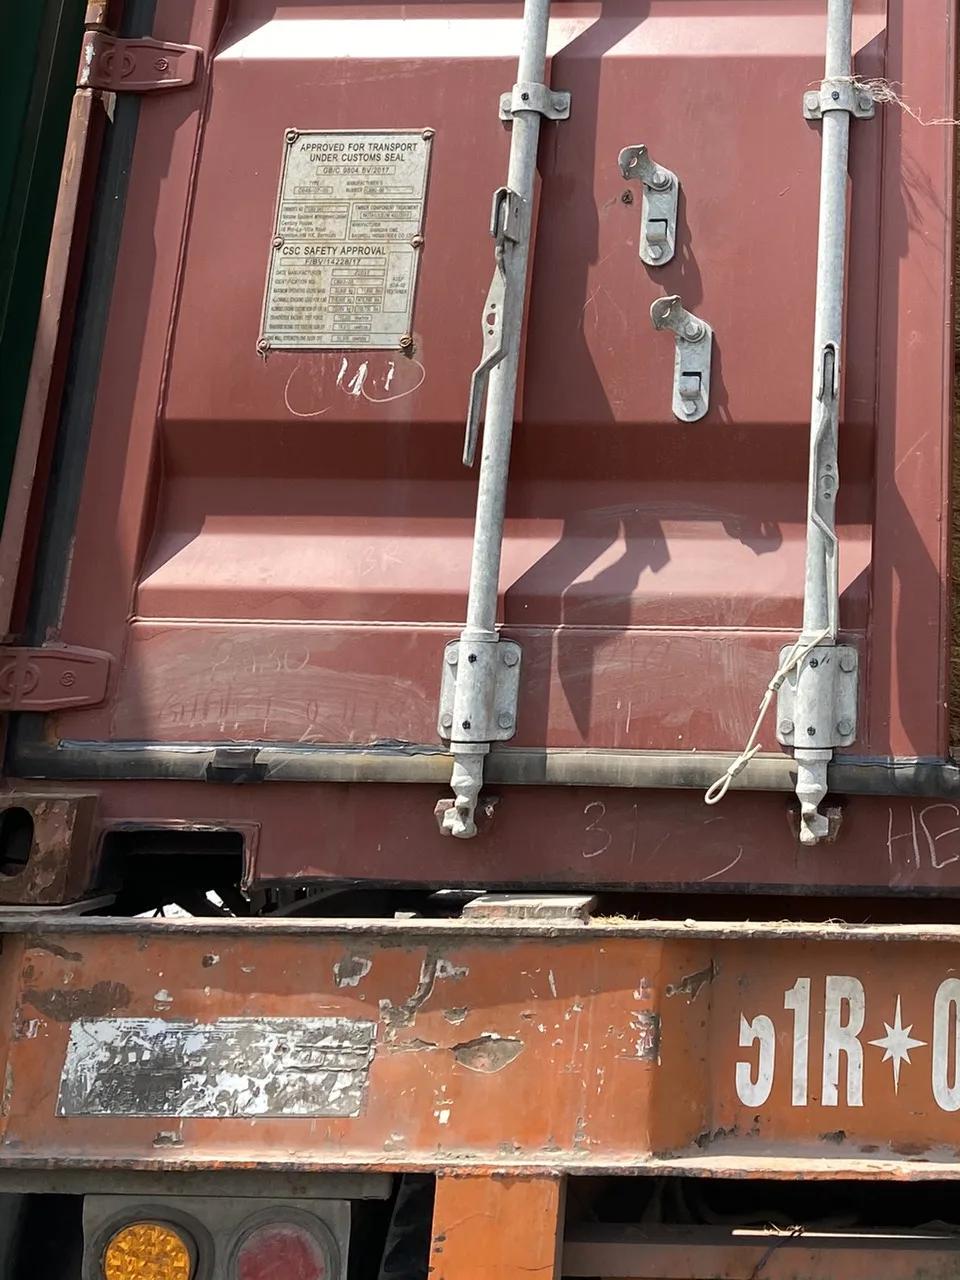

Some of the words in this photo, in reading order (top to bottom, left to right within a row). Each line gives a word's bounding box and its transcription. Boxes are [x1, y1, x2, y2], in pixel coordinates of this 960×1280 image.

[300, 143, 345, 152] APPROVED
[348, 143, 365, 152] FOR
[368, 142, 418, 152] TRANSPORT
[309, 153, 338, 162] UNDER
[341, 153, 382, 162] CUSTOMS
[384, 153, 405, 162] SEAL
[282, 246, 301, 255] CSC
[304, 246, 338, 255] SAFETY
[340, 246, 387, 255] APPROVAL
